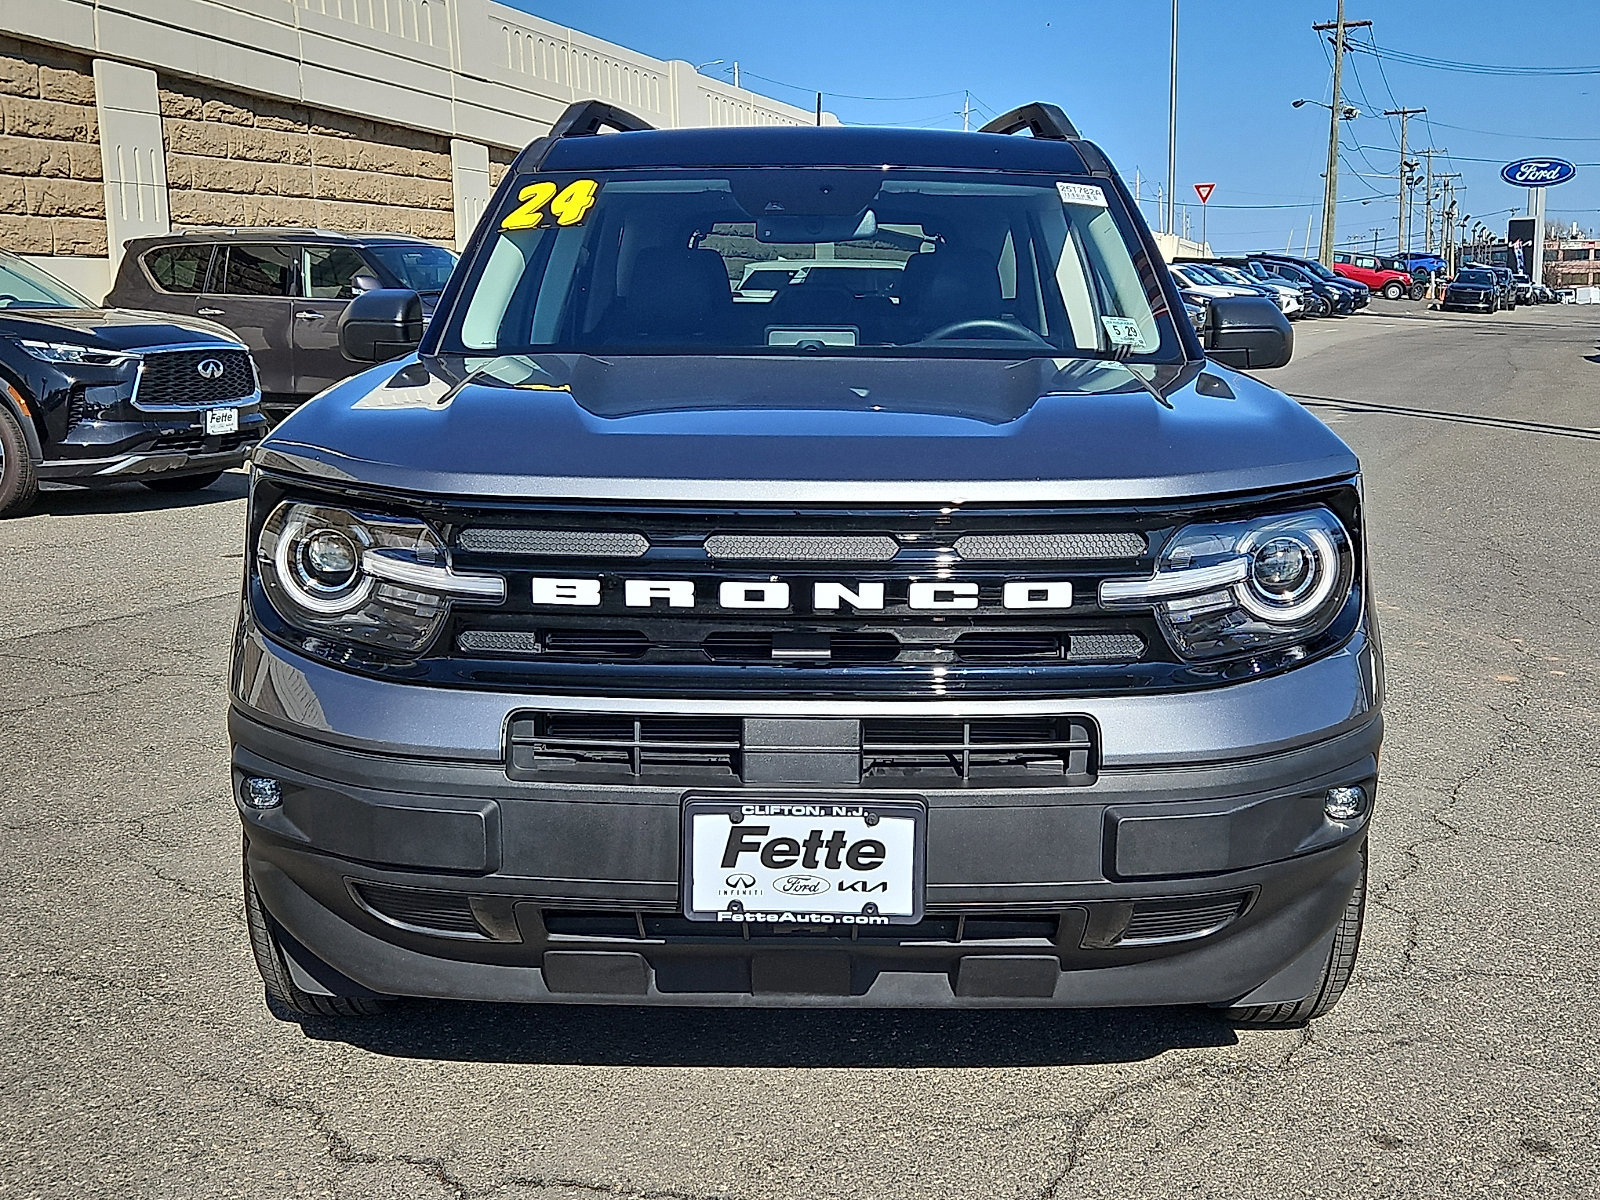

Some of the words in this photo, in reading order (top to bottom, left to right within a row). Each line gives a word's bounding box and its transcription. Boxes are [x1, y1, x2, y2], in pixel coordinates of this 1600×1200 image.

[1515, 162, 1562, 181] Ford
[501, 179, 599, 229] 24
[1112, 325, 1121, 335] 5
[1125, 326, 1137, 336] 29
[532, 577, 1073, 610] BRONCO
[741, 805, 826, 816] CLIFTON,
[832, 807, 869, 817] N.J.
[721, 825, 887, 871] Fette
[782, 877, 821, 893] Ford
[837, 880, 888, 893] KIA
[717, 911, 890, 925] FetteAuto.com
